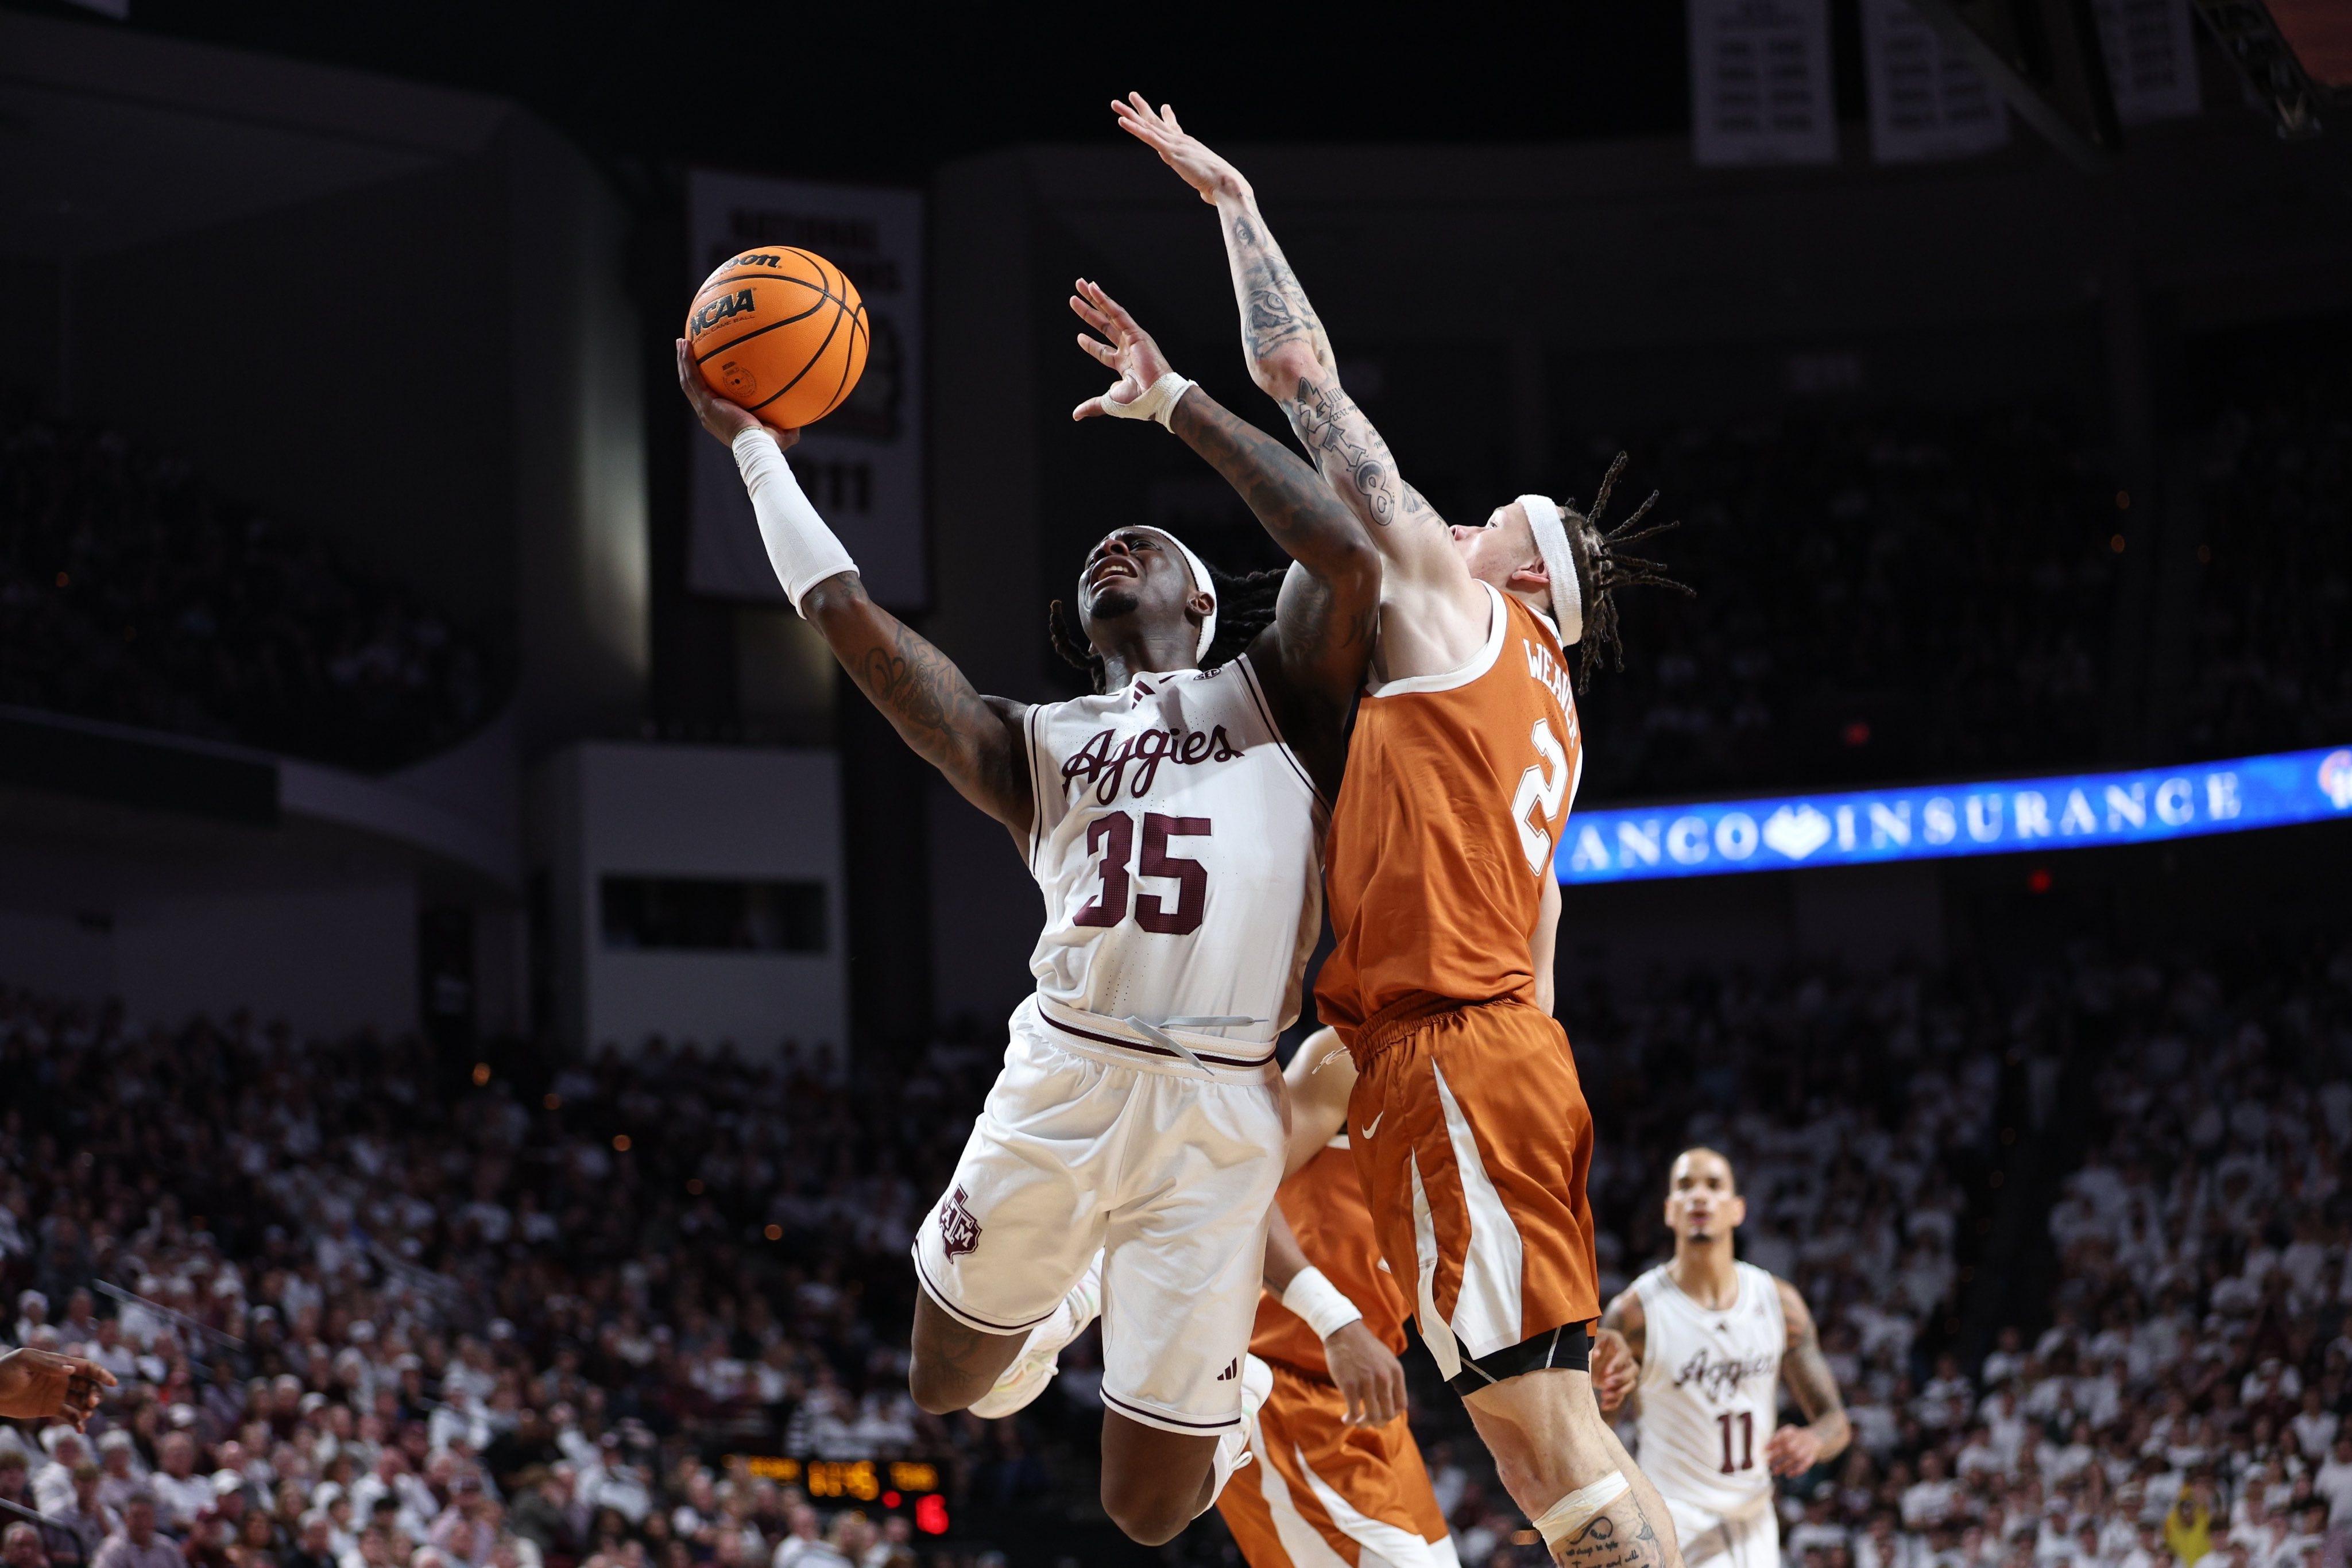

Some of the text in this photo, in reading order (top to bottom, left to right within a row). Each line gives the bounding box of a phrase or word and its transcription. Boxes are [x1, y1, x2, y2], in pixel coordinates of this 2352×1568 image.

[690, 288, 755, 341] NCAA
[1062, 725, 1245, 806] Aggies
[1511, 718, 1568, 877] 2
[1572, 771, 2241, 872] ANCO INSURANCE
[1073, 810, 1212, 935] 35
[1717, 1411, 1753, 1474] 11
